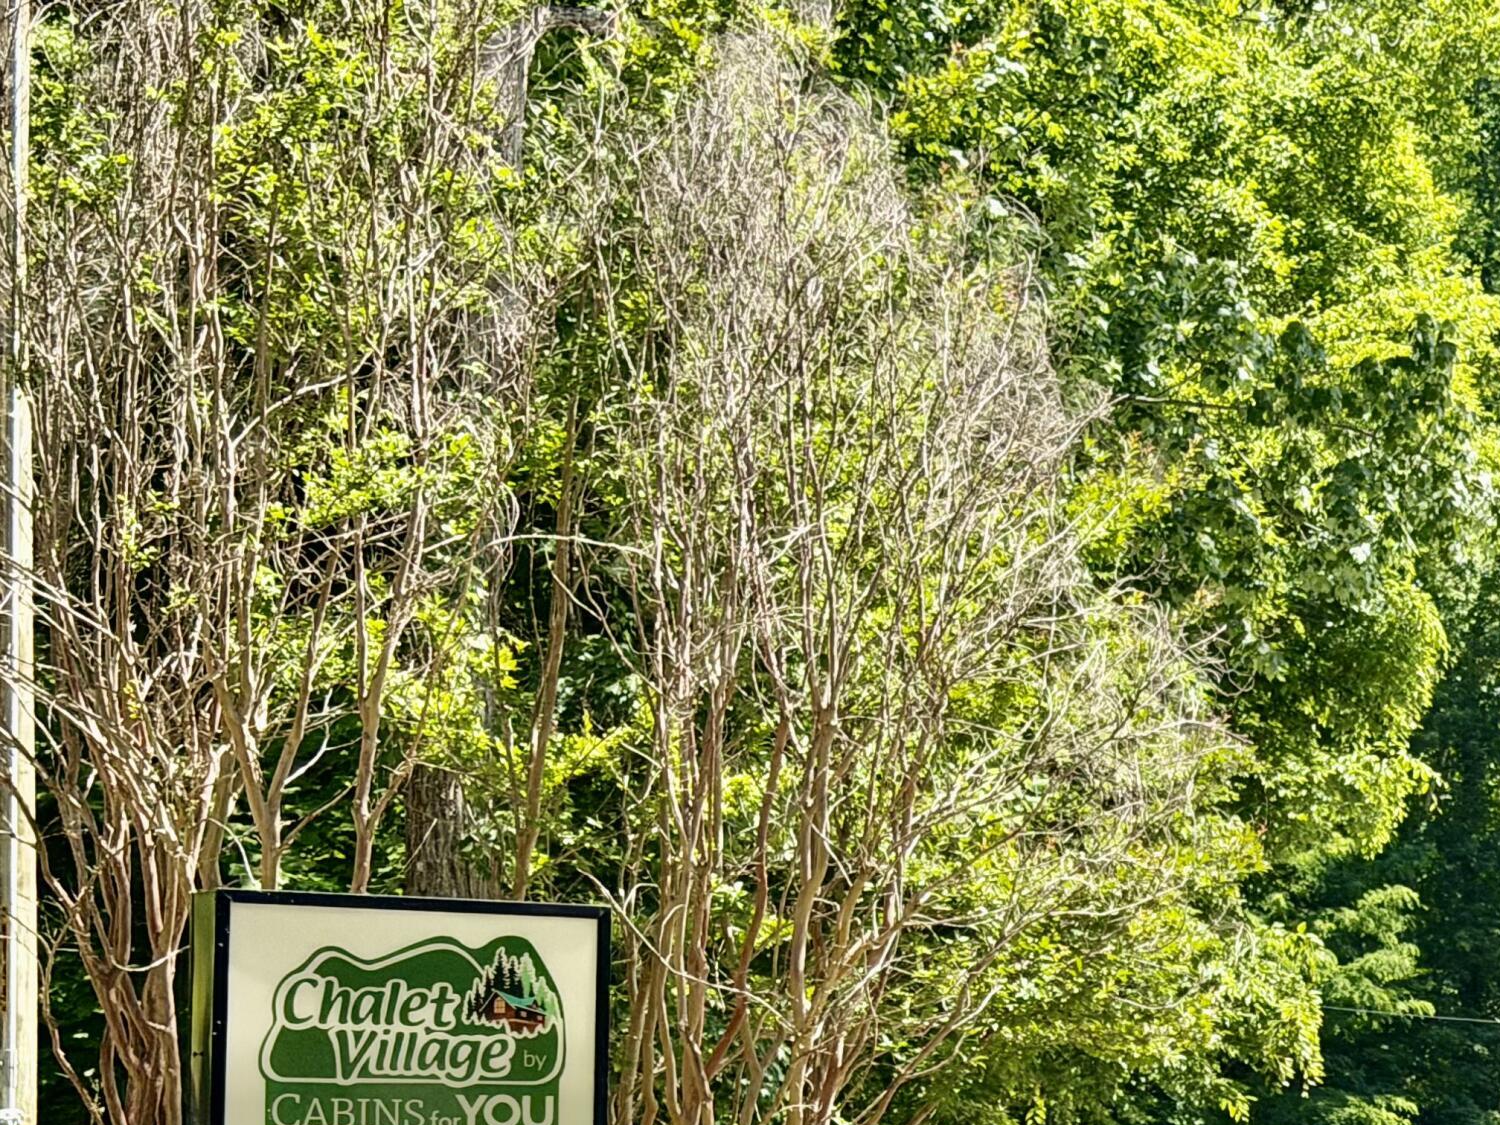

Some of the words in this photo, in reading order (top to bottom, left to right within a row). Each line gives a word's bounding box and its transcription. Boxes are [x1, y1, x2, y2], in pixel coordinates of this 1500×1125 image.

[283, 977, 457, 1028] Chalet
[334, 1027, 510, 1082] Village
[523, 1052, 547, 1071] by
